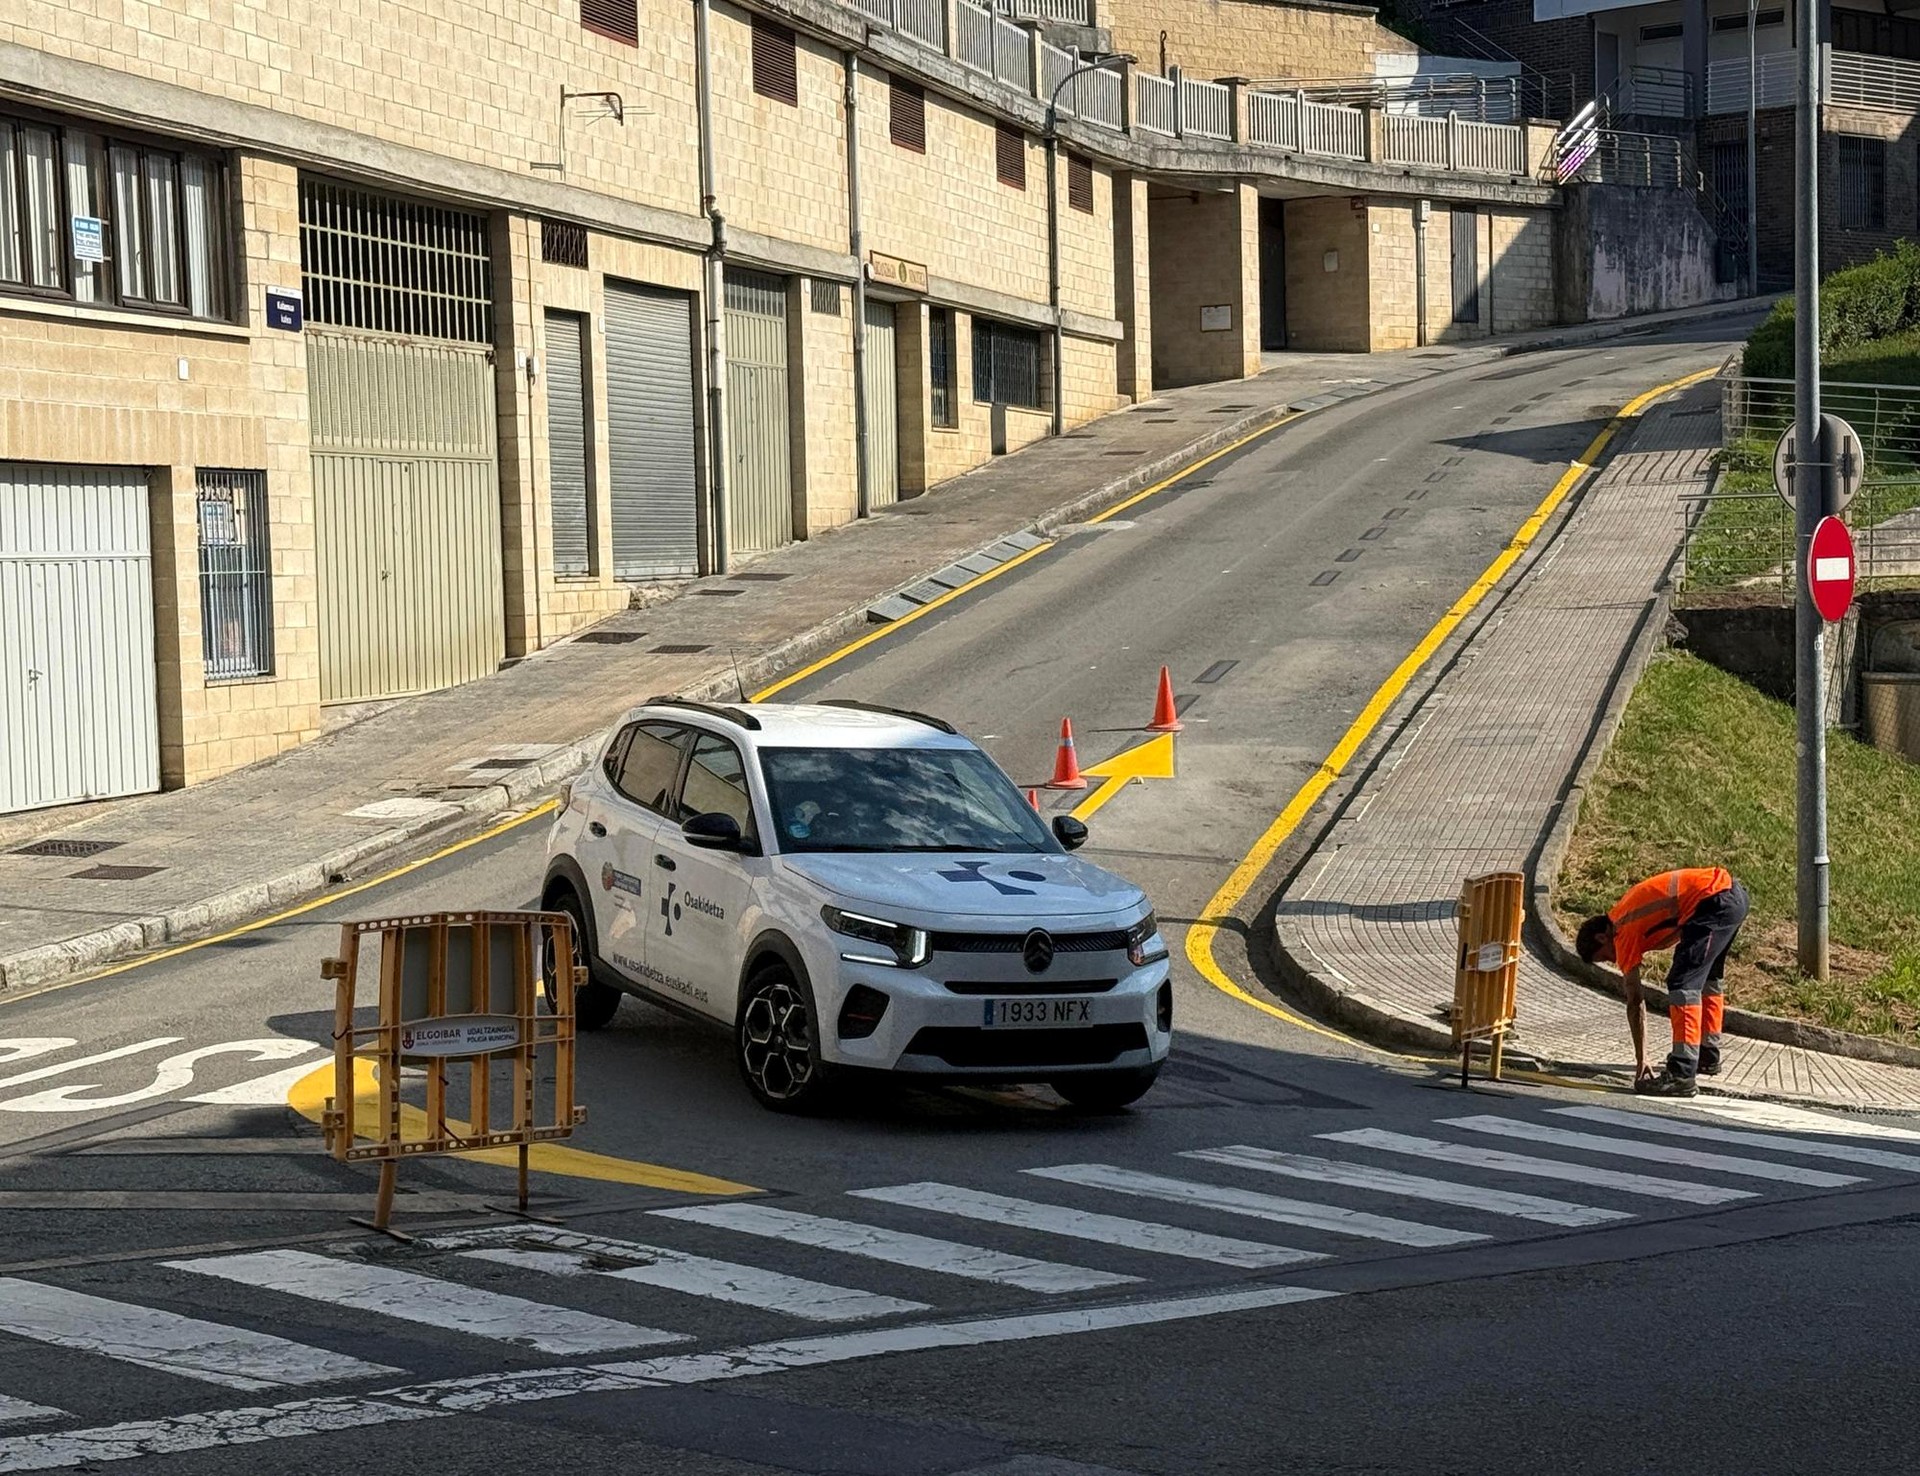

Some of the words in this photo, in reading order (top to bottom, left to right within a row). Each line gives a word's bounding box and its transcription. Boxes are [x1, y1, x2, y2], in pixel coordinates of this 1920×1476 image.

[684, 890, 725, 920] Osakidetza
[1001, 1001, 1047, 1022] 1933
[1053, 1000, 1090, 1021] NFX
[416, 1029, 461, 1040] ELGOIBAR
